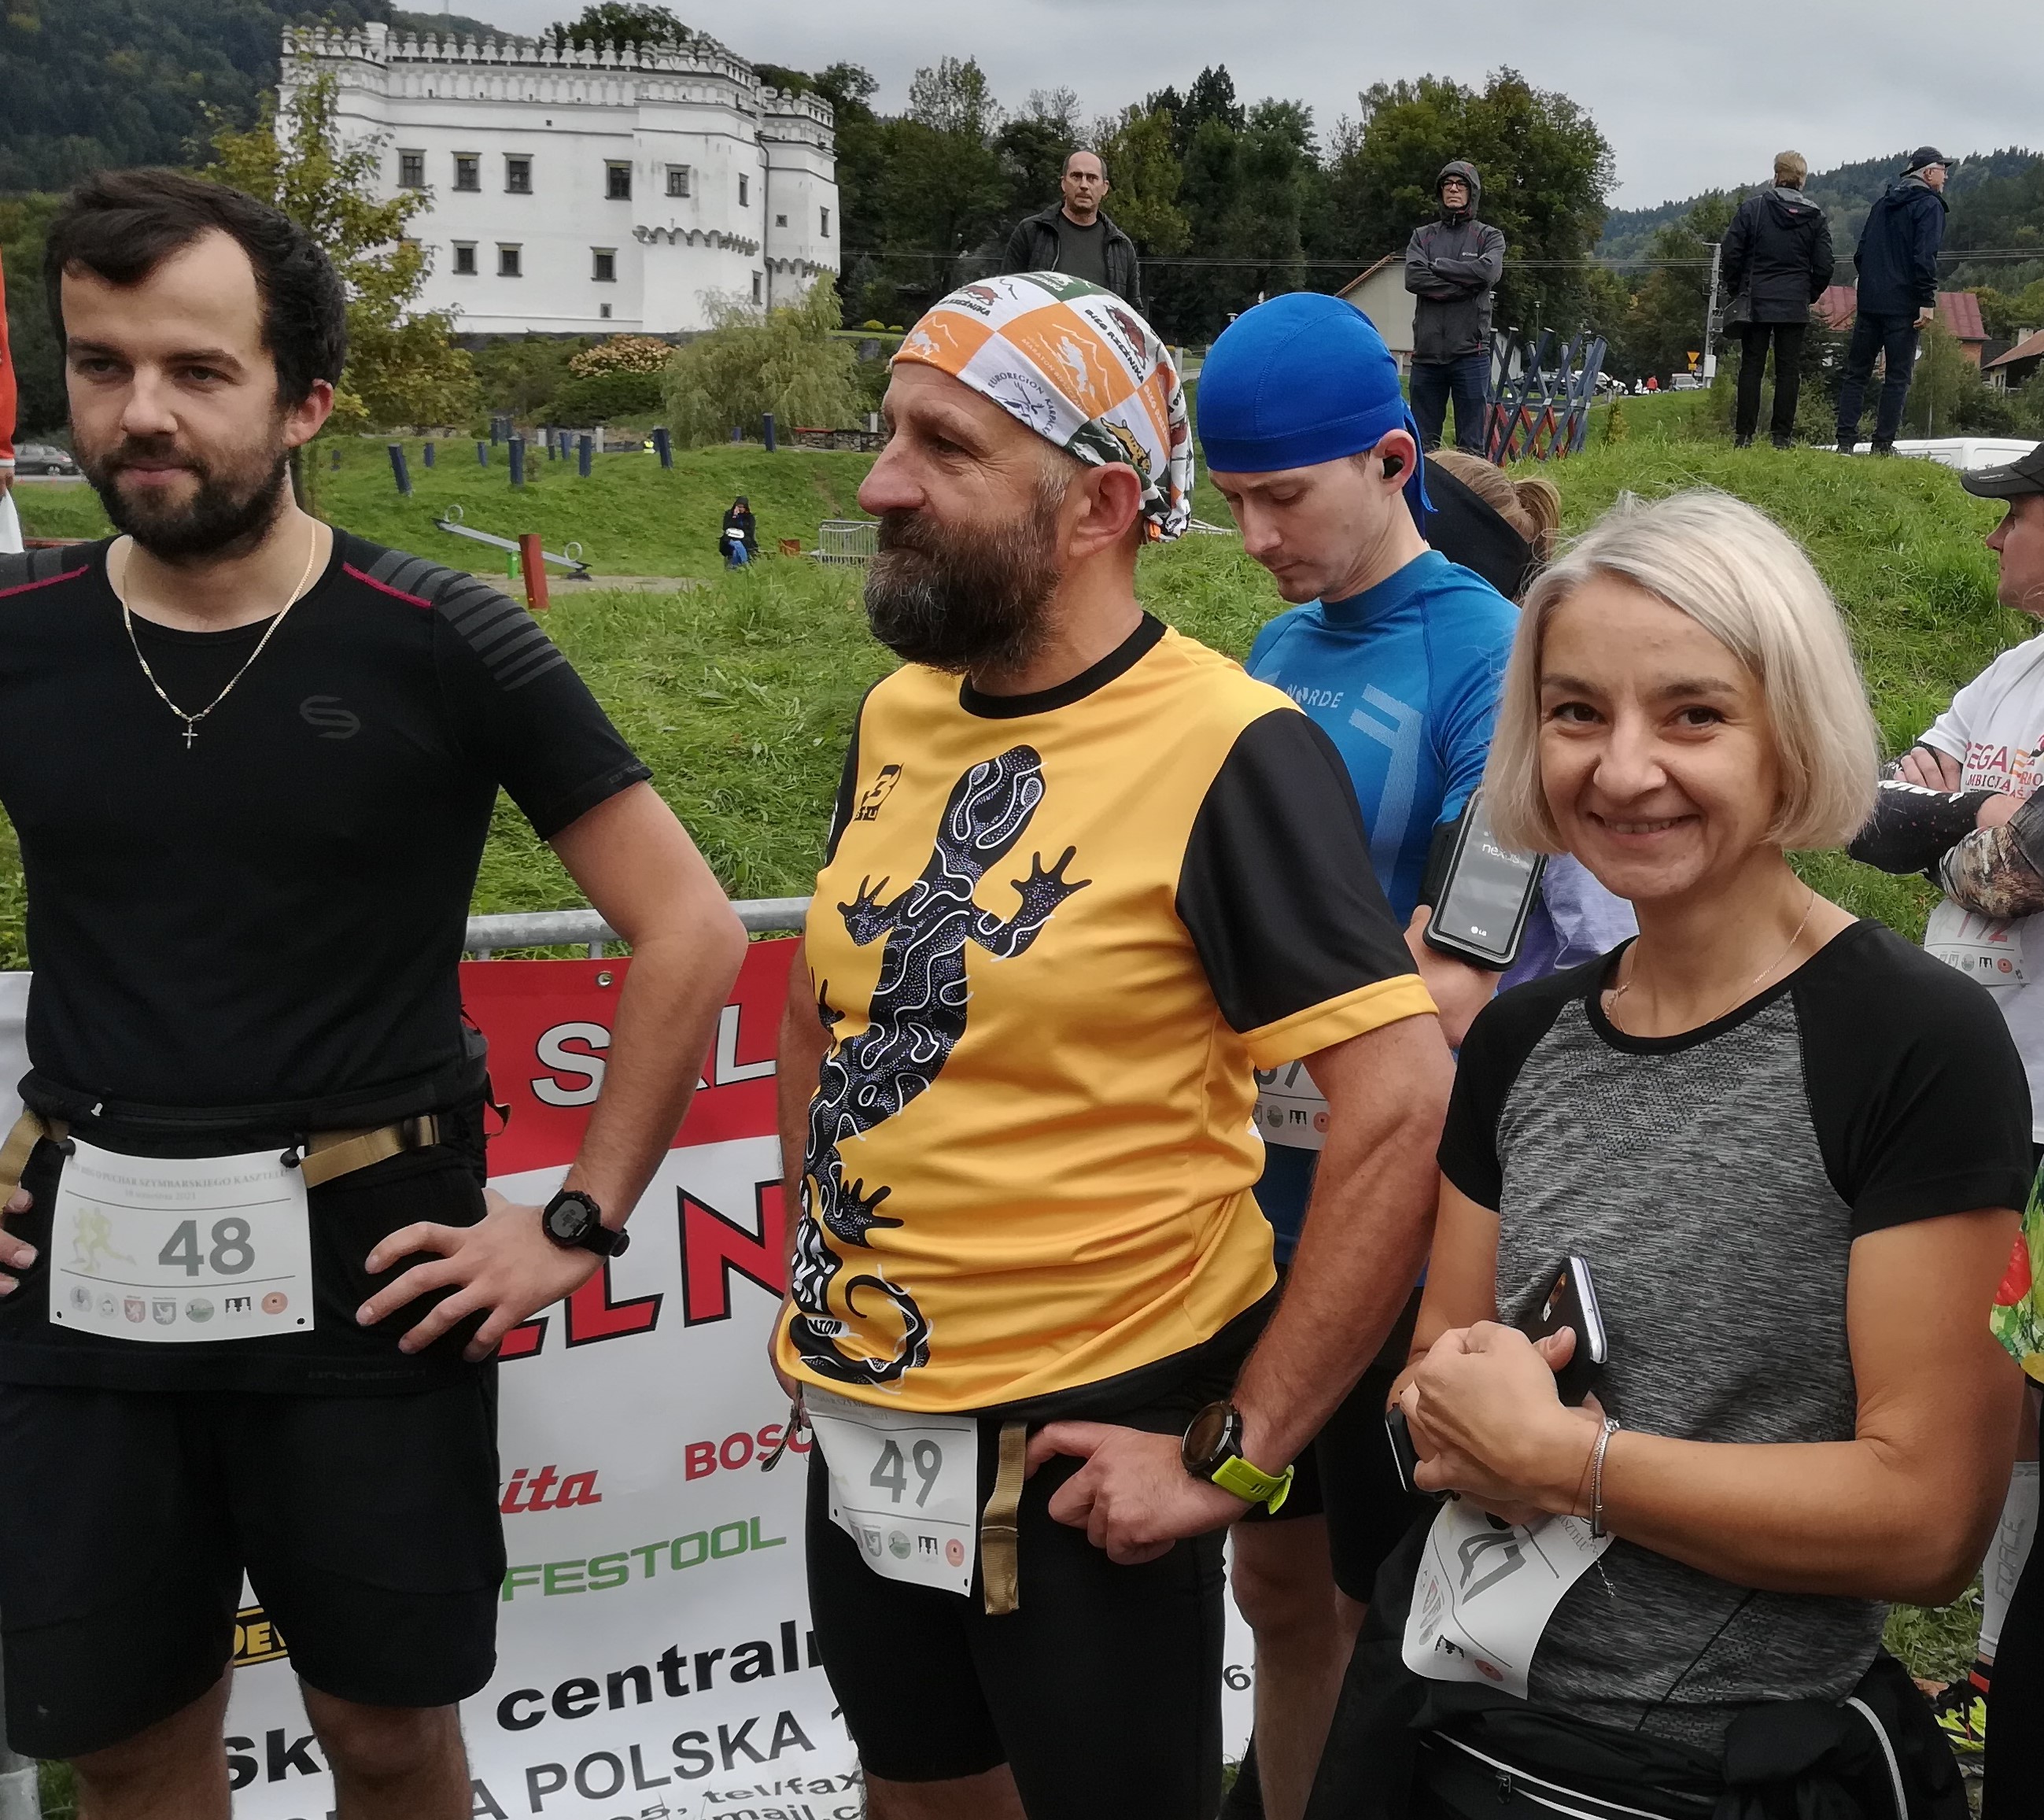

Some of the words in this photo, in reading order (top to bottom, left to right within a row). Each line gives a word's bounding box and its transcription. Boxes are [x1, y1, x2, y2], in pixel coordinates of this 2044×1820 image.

[987, 371, 1045, 395] EUROREGION
[158, 1216, 256, 1277] 48
[870, 1439, 943, 1508] 49
[502, 1515, 788, 1603] FESTOOL
[526, 1710, 817, 1814] POLSKA
